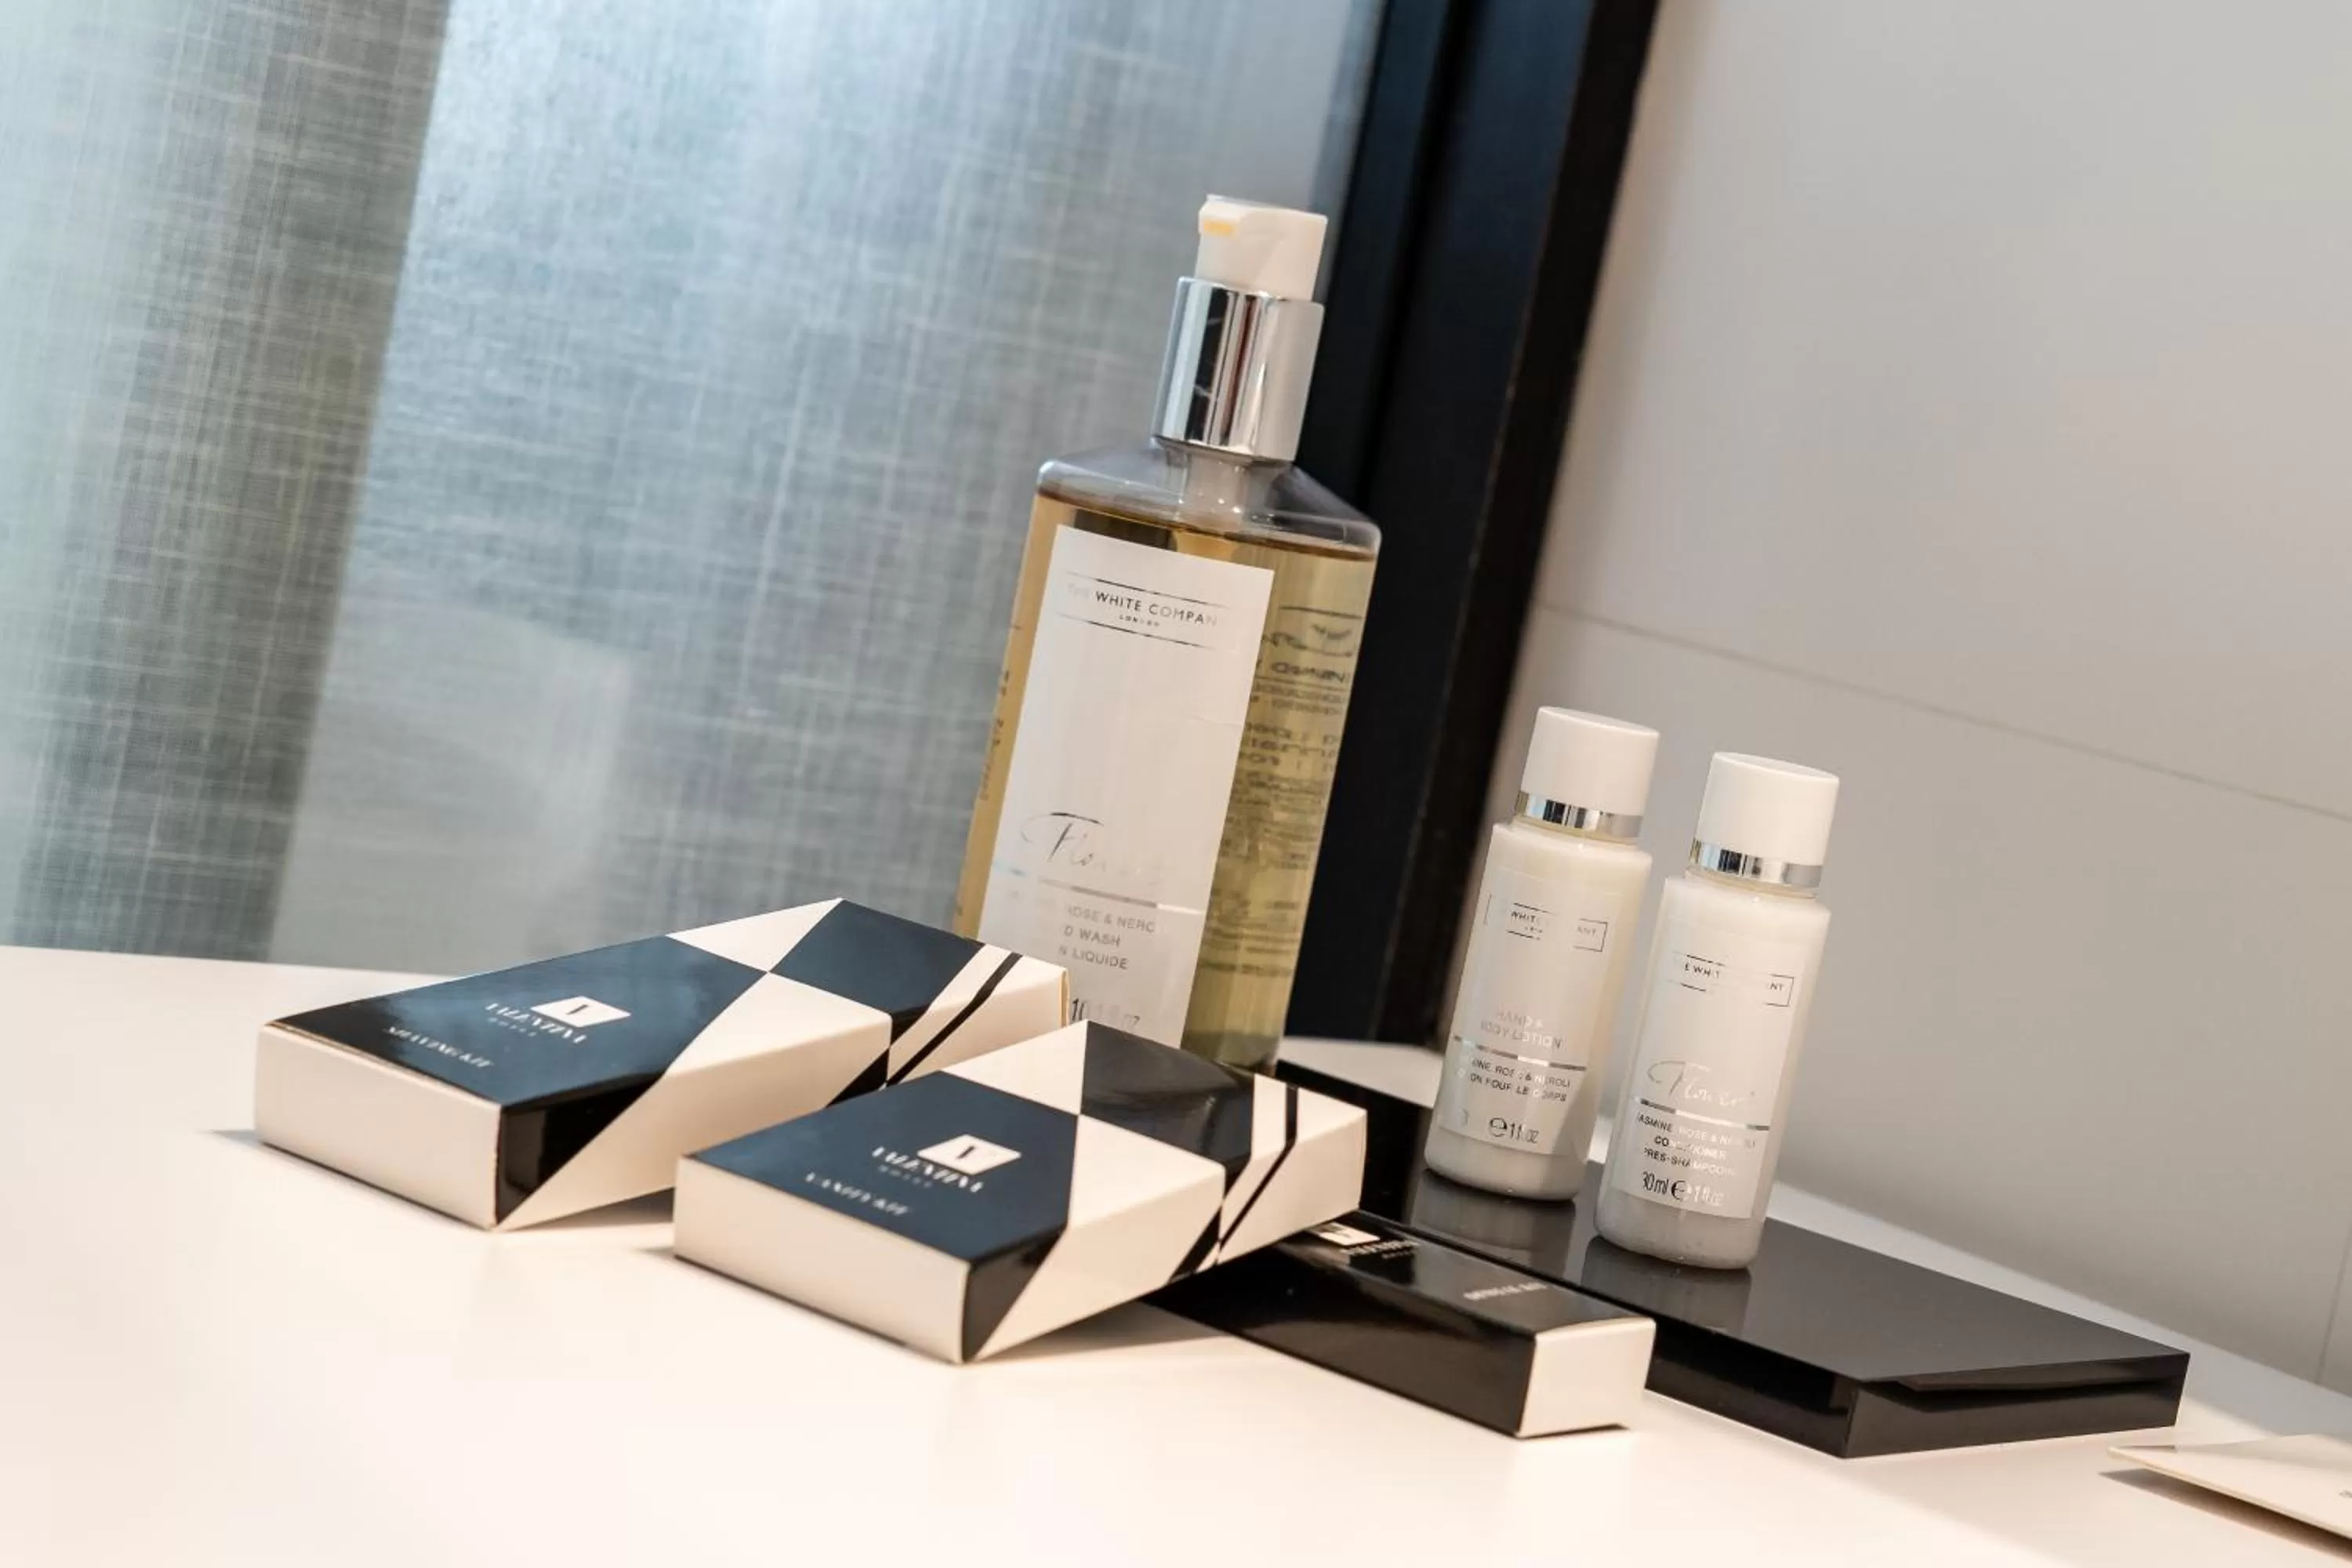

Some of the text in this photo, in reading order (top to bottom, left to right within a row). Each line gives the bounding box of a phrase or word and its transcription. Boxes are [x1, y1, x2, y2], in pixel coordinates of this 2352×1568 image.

[1096, 591, 1142, 612] WHITE
[1149, 603, 1218, 626] COMPAN
[1120, 615, 1161, 626] LONON
[1511, 910, 1539, 924] WHIT
[1080, 927, 1121, 947] WASH
[1072, 947, 1128, 970] LIQUIDE
